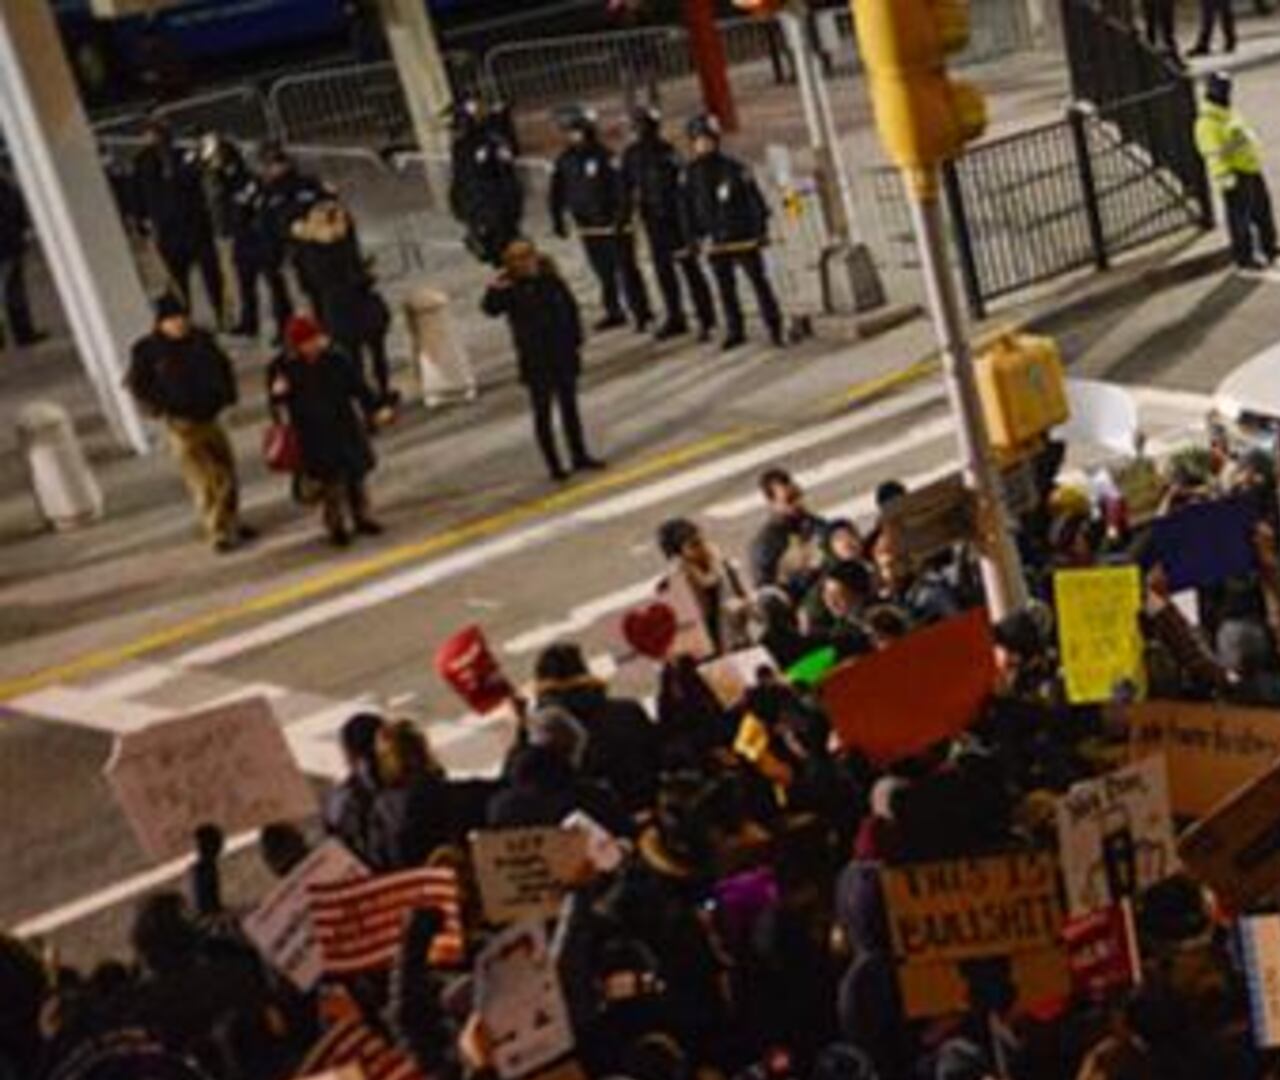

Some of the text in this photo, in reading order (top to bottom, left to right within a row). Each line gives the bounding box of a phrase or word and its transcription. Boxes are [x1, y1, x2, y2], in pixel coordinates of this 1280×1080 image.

[902, 851, 1052, 898] THIS IS
[902, 897, 1055, 955] BULLSHIT
